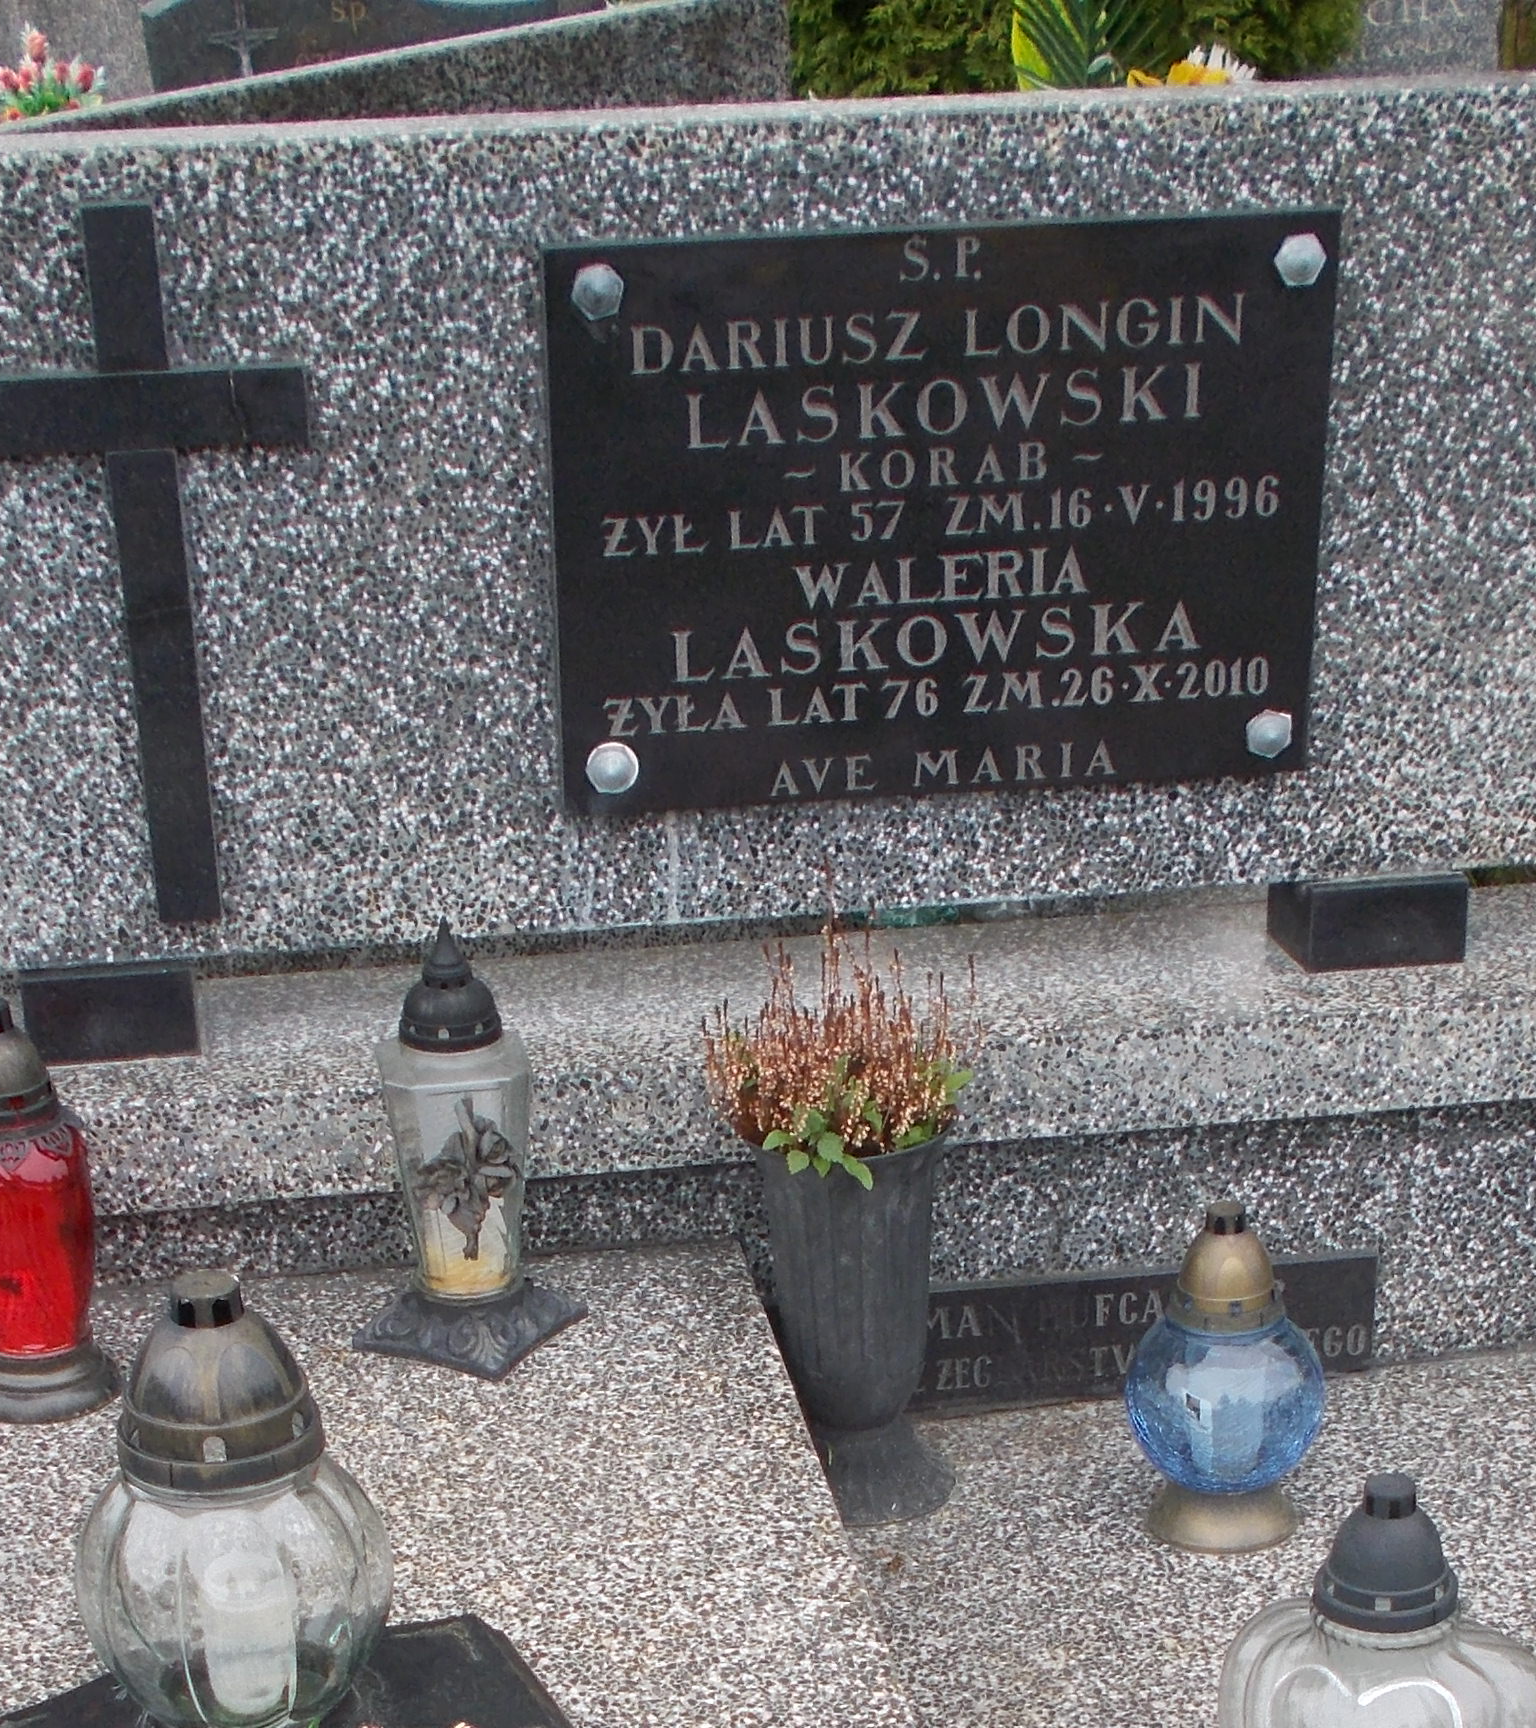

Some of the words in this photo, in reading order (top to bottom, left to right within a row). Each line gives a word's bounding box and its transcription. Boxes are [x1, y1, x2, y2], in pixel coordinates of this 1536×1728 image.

[631, 311, 927, 375] DARIUSZ
[964, 292, 1245, 357] LONGIN
[685, 362, 1201, 450] LASKOWSKI
[727, 504, 825, 550] LAT
[851, 499, 904, 542] 57
[792, 545, 1090, 609] WALERIA
[670, 600, 1202, 683] LASKOWSKA
[767, 681, 869, 727] LAT
[880, 677, 938, 718] 76
[771, 753, 878, 797] AVE
[913, 739, 1116, 787] MARIA
